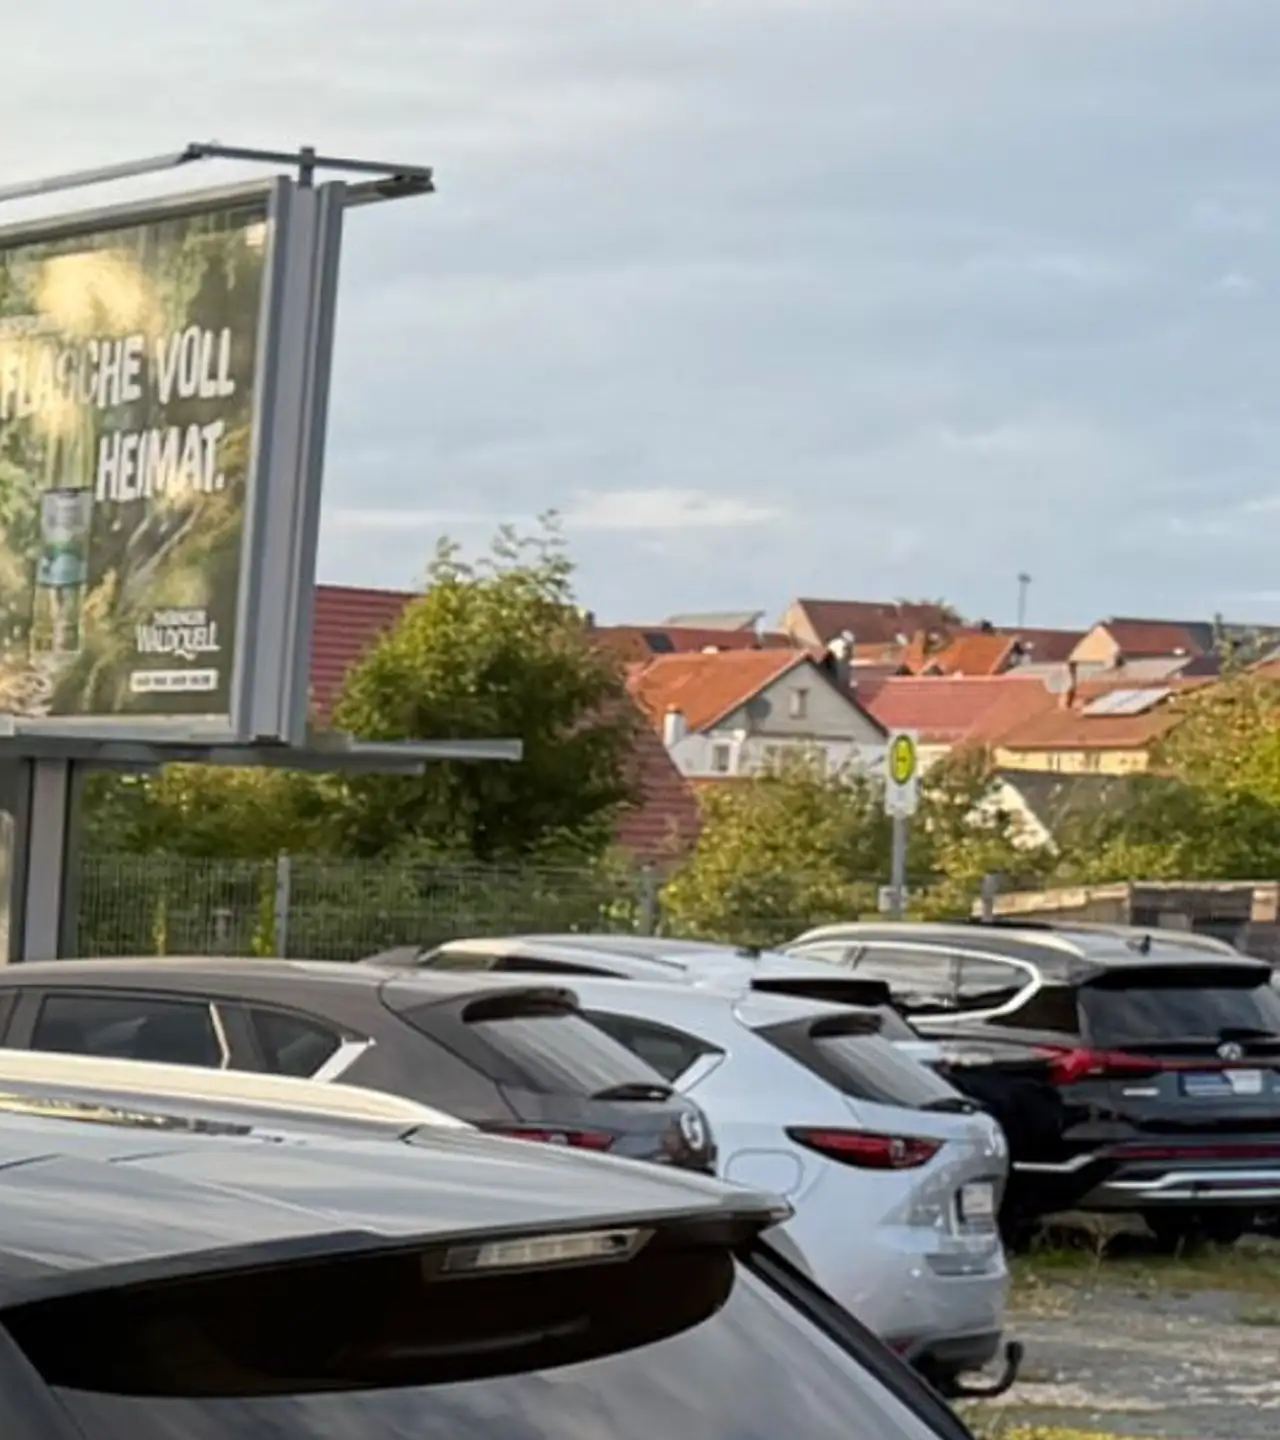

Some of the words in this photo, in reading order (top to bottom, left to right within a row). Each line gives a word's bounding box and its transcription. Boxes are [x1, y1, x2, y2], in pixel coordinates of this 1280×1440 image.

[0, 333, 146, 421] FLASCHE
[156, 324, 236, 405] VOLL
[95, 419, 227, 502] HEIMAT.
